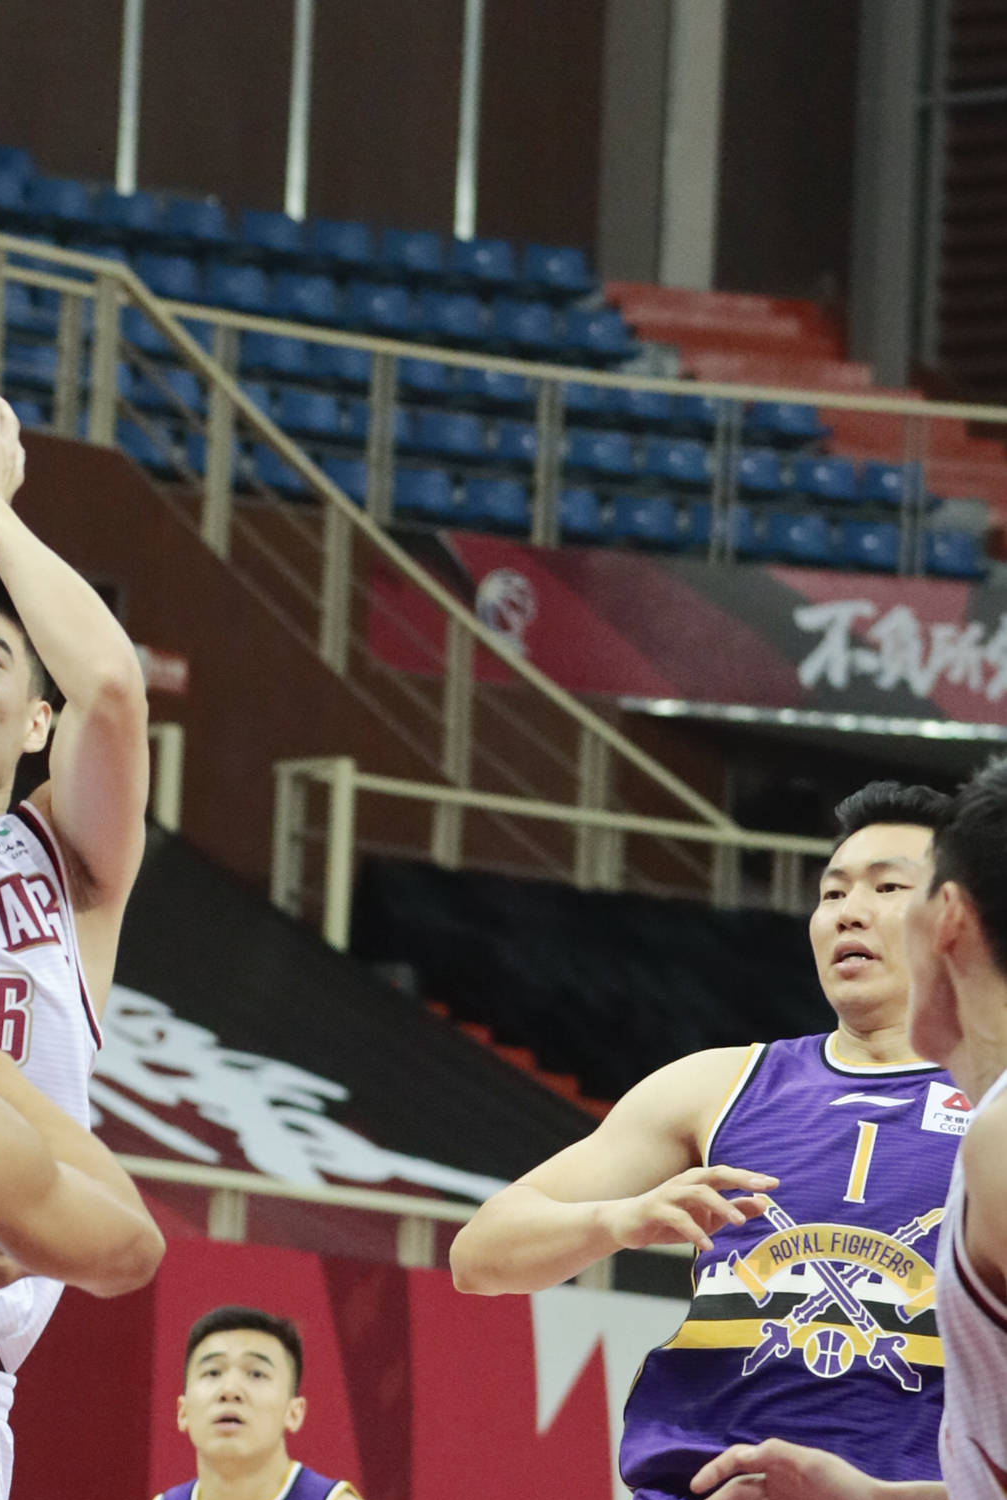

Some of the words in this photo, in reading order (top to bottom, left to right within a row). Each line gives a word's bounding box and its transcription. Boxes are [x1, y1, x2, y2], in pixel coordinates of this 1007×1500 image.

[843, 1120, 879, 1204] 1
[769, 1231, 825, 1266] ROYAL
[830, 1231, 915, 1279] FIGHTERS
